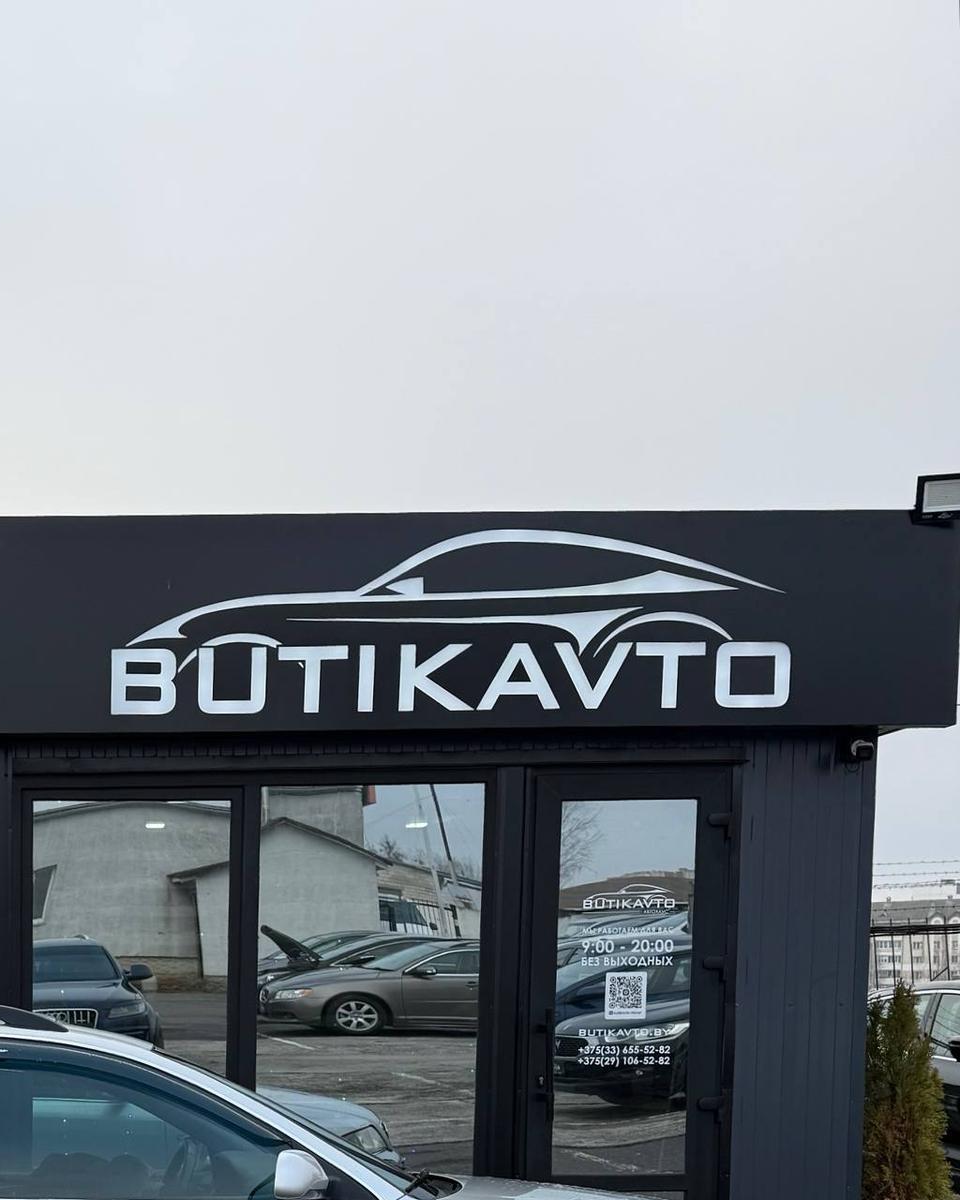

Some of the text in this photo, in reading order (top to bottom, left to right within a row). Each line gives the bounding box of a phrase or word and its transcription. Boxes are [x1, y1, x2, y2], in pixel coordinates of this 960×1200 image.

[110, 641, 792, 716] BUTIKAVTO
[583, 898, 675, 909] BUTIKAVTO
[581, 940, 614, 953] 9:00
[631, 939, 674, 953] 20:00
[581, 956, 674, 967] БЕЗ ВЫХОДНЫХ
[578, 1028, 671, 1037] BUTIKAVTO.BY
[578, 1045, 671, 1056] +375(33) 655-52-82
[578, 1056, 671, 1067] +375(29) 106-52-82
